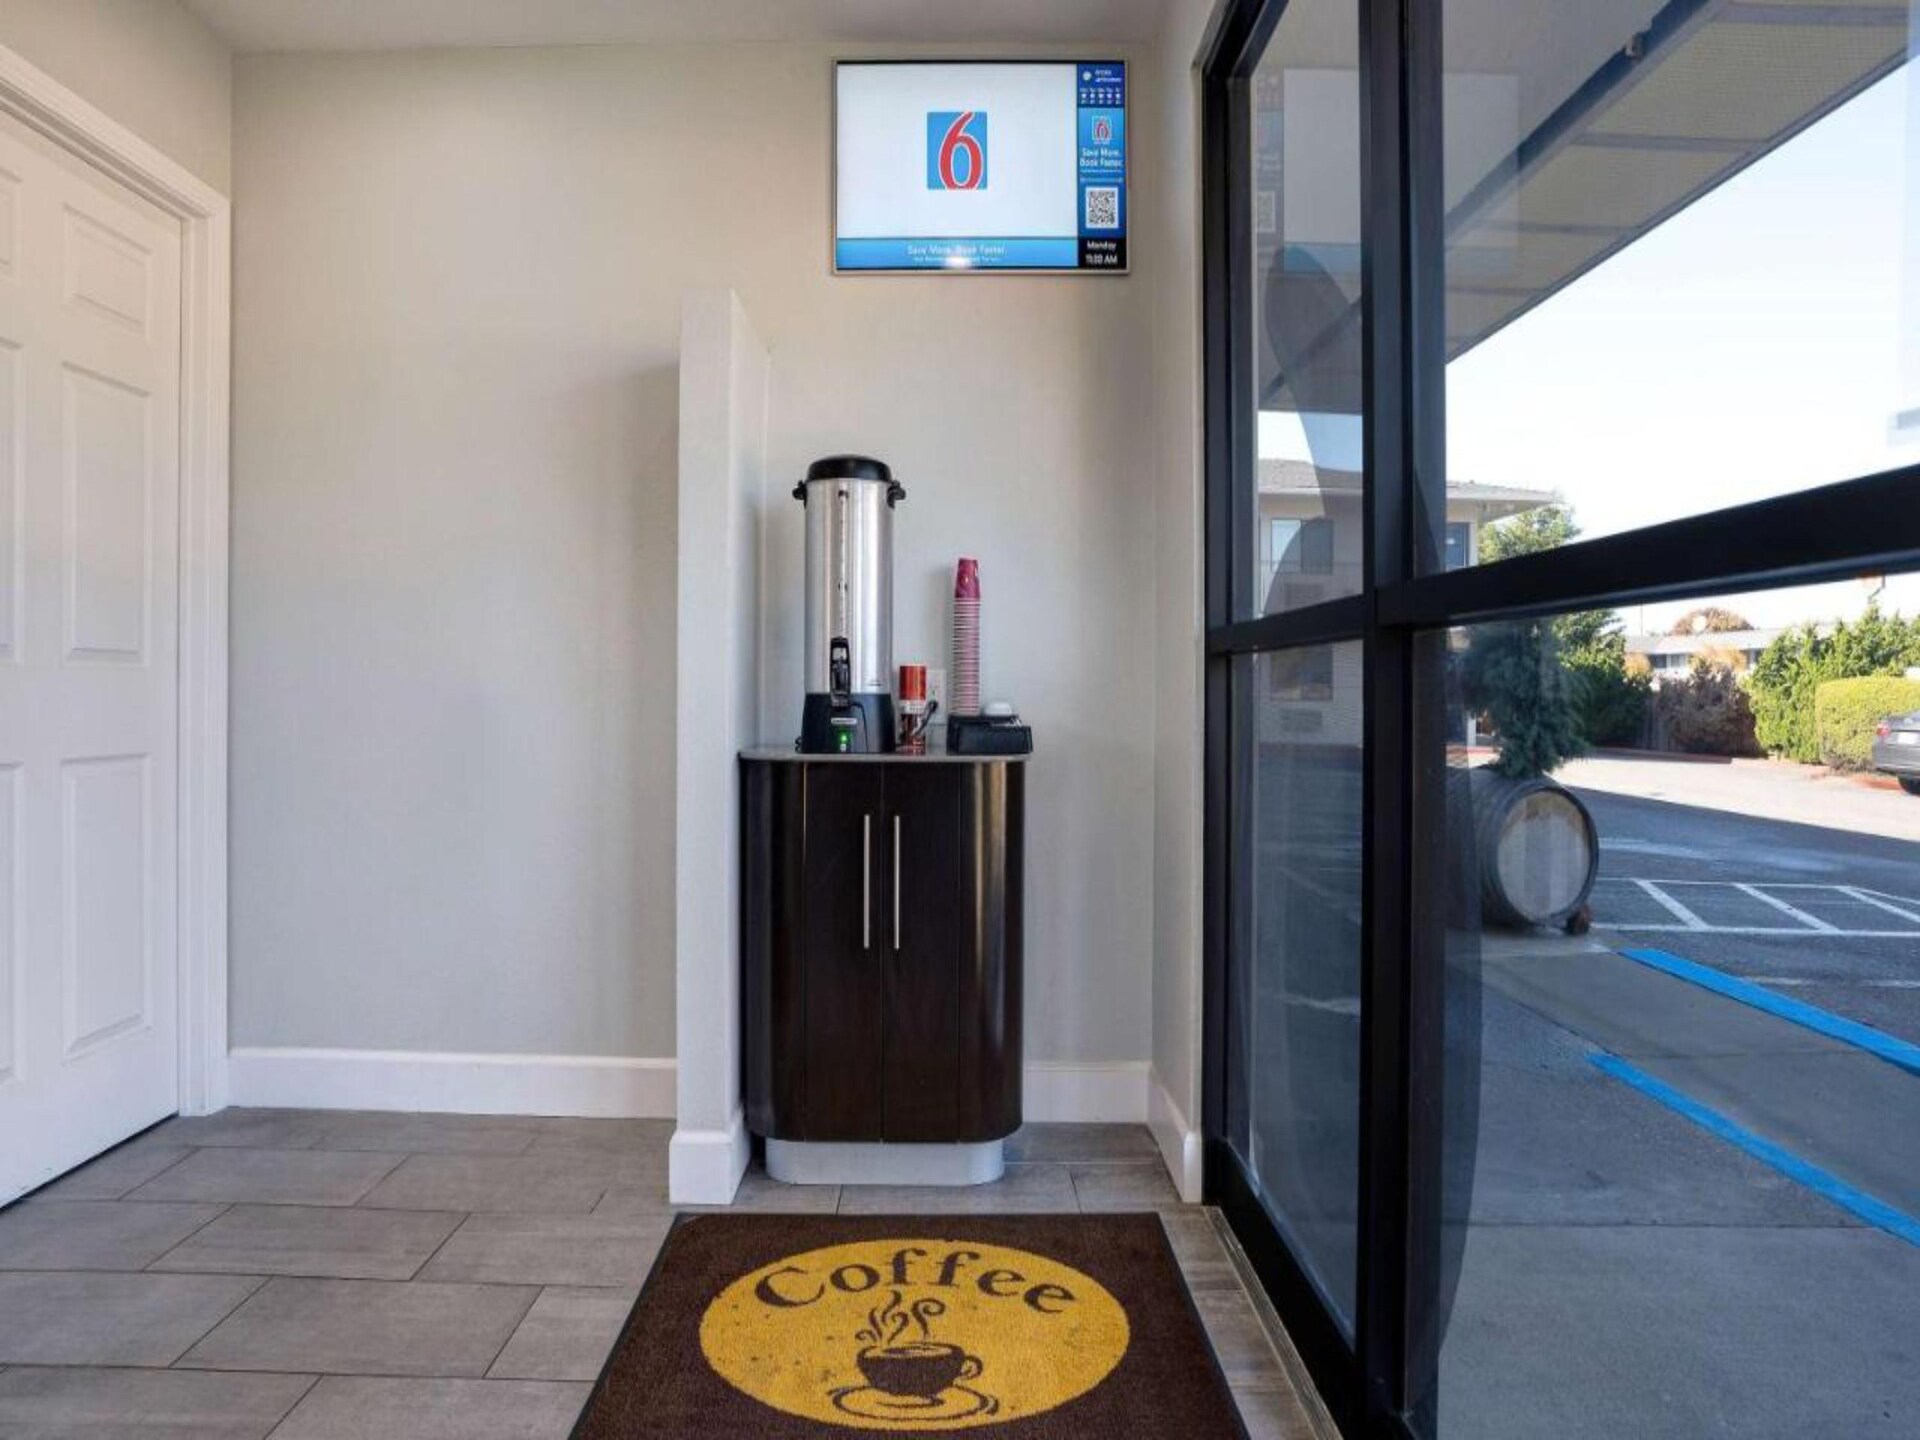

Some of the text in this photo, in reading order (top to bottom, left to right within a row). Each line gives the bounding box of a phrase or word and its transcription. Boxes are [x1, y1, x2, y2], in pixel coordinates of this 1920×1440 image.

[938, 111, 984, 190] 6
[1086, 240, 1117, 252] Monday
[1104, 253, 1119, 265] AM
[754, 1247, 1077, 1313] Coffee
